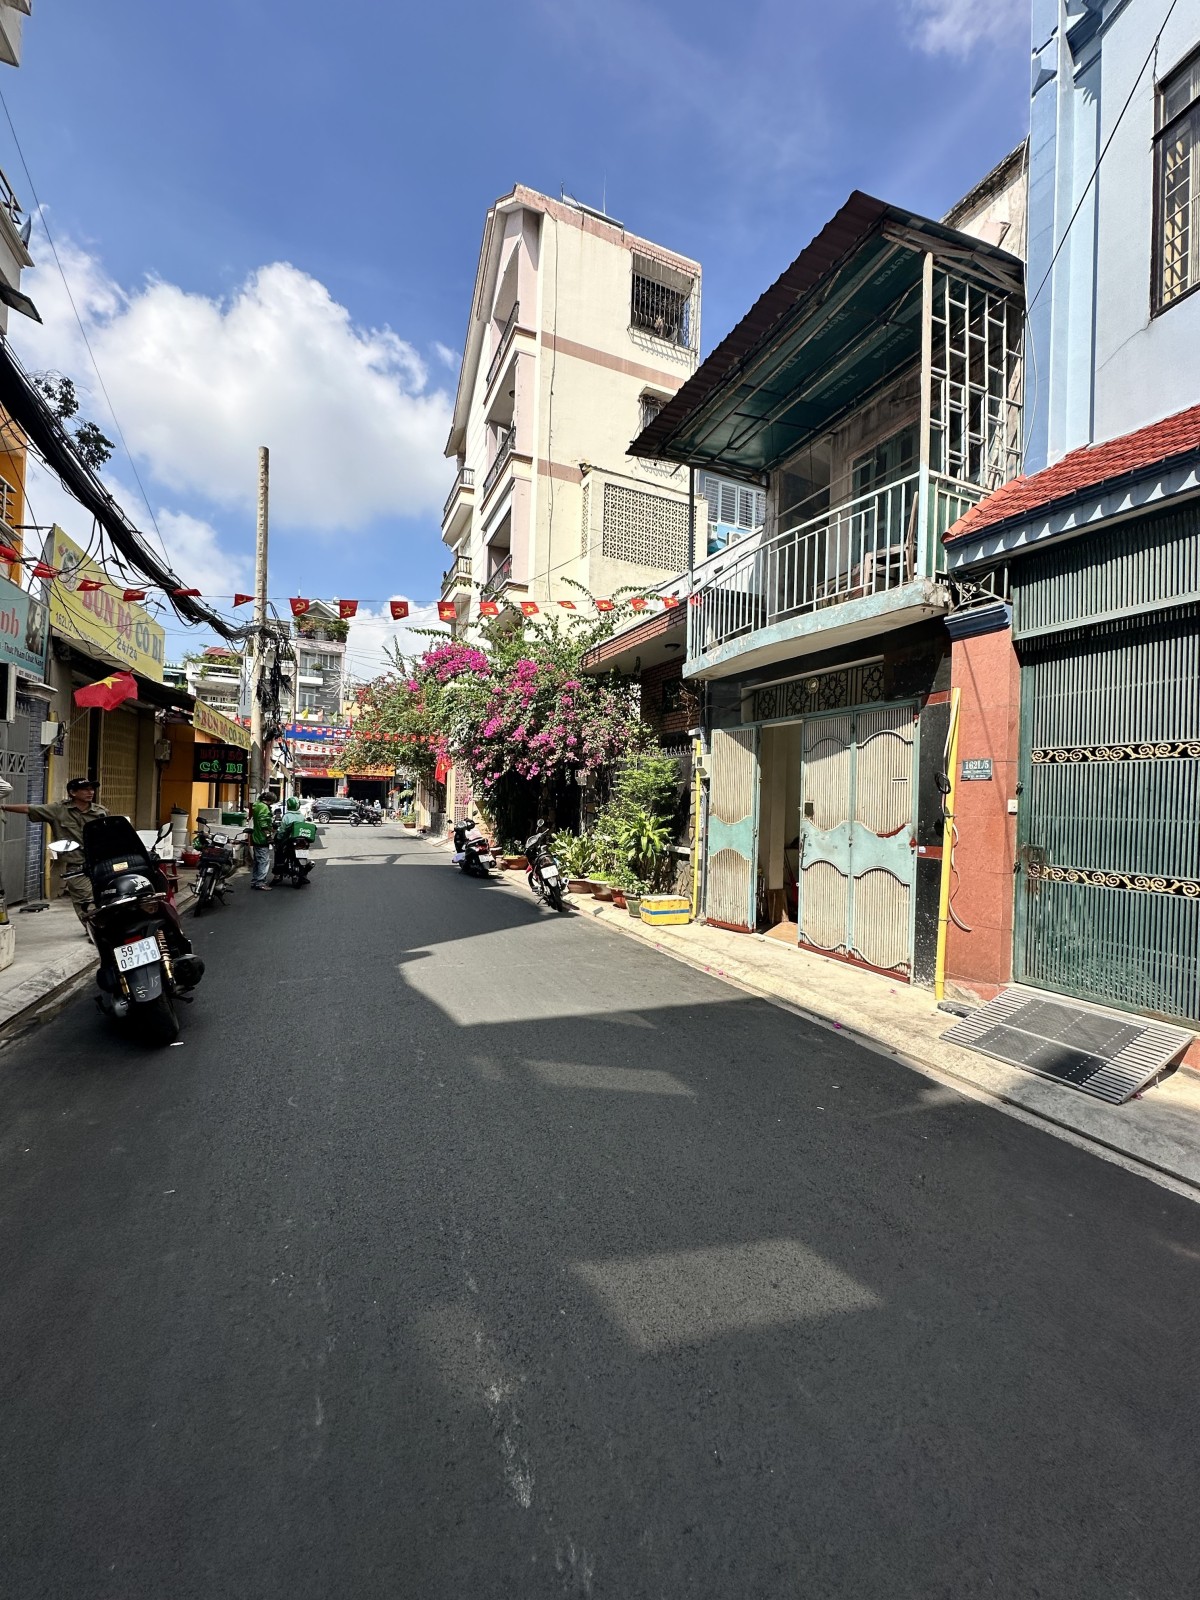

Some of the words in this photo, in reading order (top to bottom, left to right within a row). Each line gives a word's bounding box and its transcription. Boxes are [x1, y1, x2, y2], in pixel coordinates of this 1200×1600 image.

[116, 638, 138, 661] 24/24
[135, 618, 150, 653] CÔ
[152, 633, 162, 665] BI
[200, 760, 221, 772] CÔ
[226, 763, 243, 773] BI
[964, 760, 990, 770] 162L/5
[121, 940, 151, 958] 59-N3
[120, 949, 158, 970] 037.18
